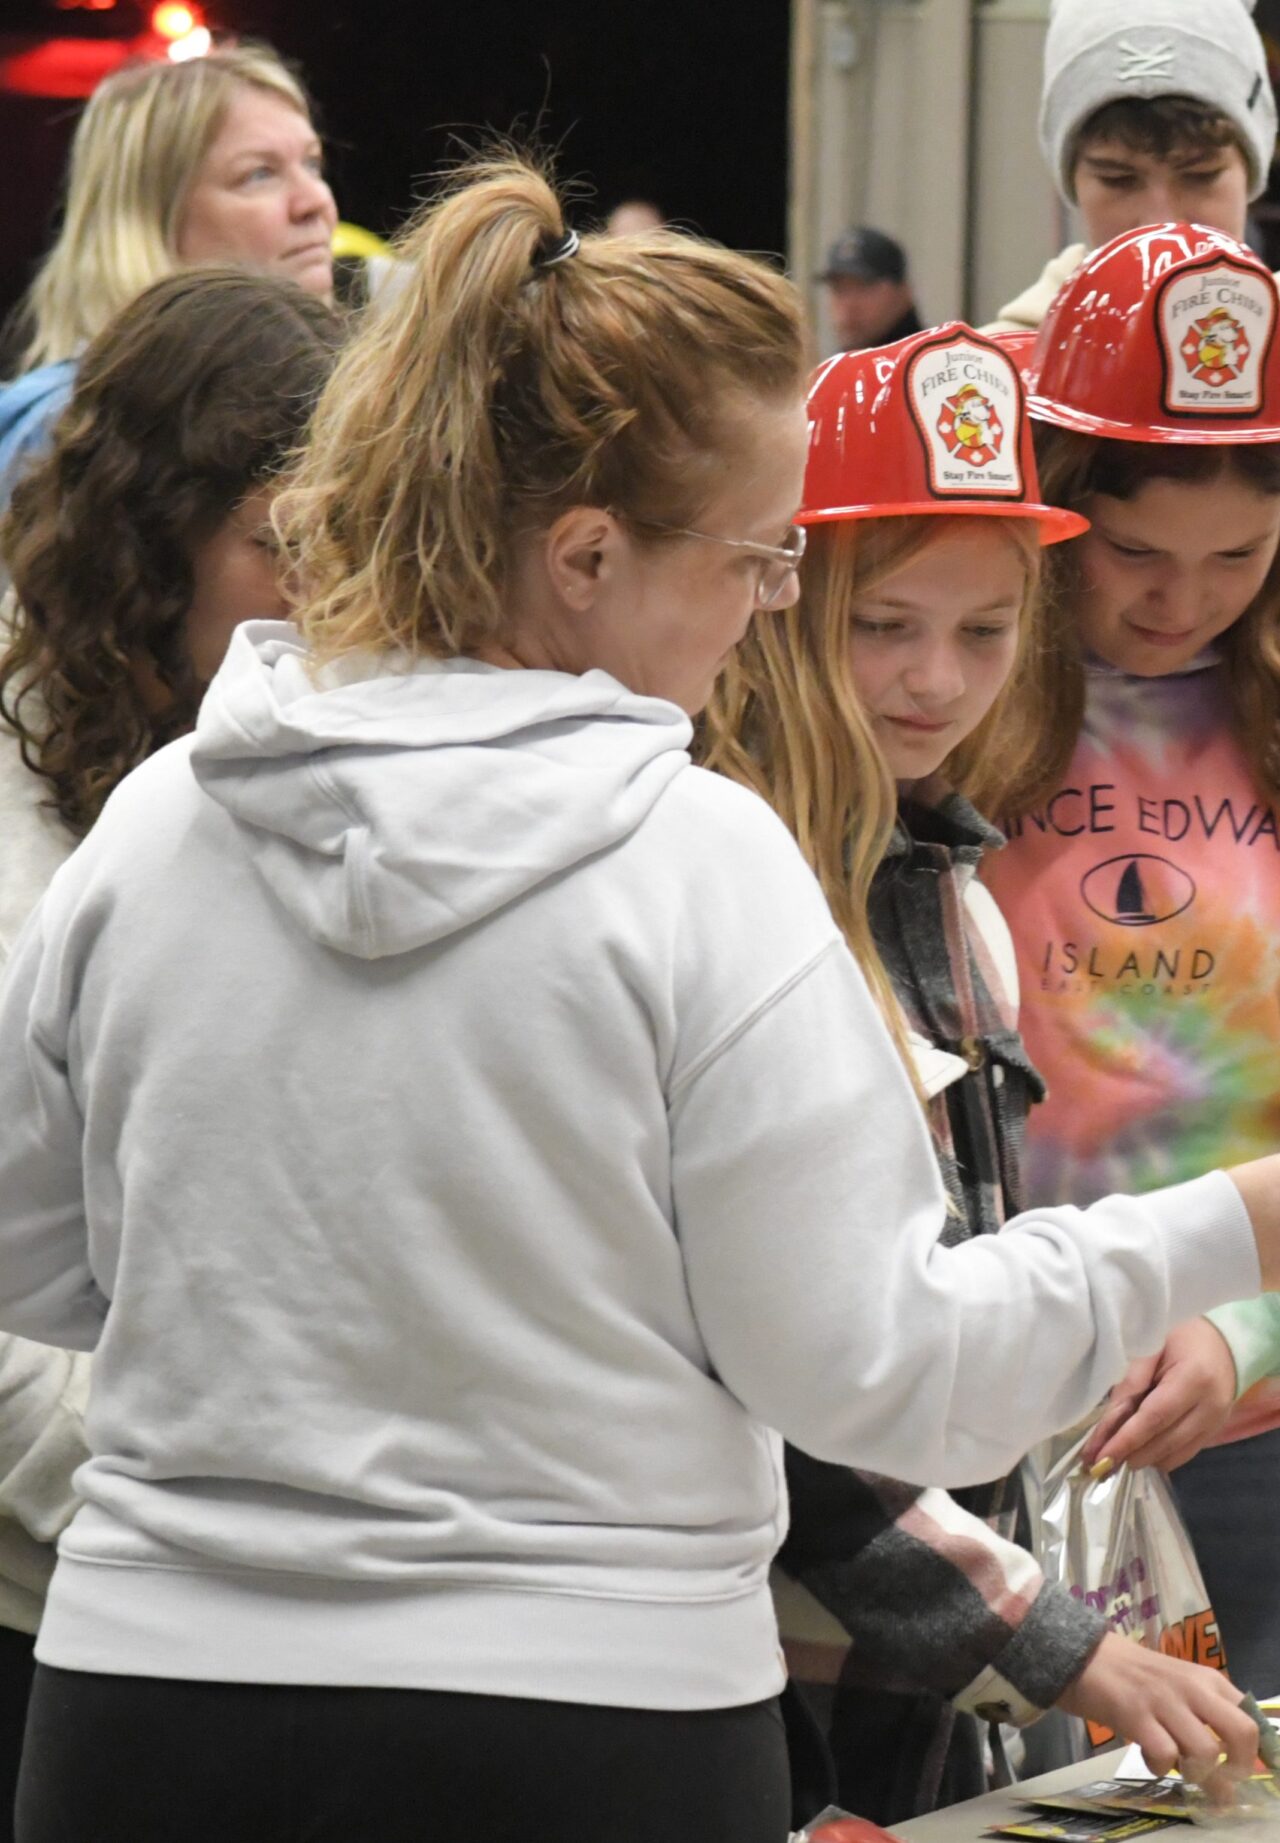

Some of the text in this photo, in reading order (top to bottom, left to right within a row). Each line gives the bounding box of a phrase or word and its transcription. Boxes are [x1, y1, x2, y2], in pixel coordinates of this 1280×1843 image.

[1172, 291, 1210, 320] FIRE
[945, 351, 983, 367] Junior
[921, 367, 958, 397] FIRE
[1178, 390, 1200, 401] Stay
[943, 471, 965, 482] Stay
[966, 470, 985, 480] Fire
[1042, 941, 1216, 981] ISLAND
